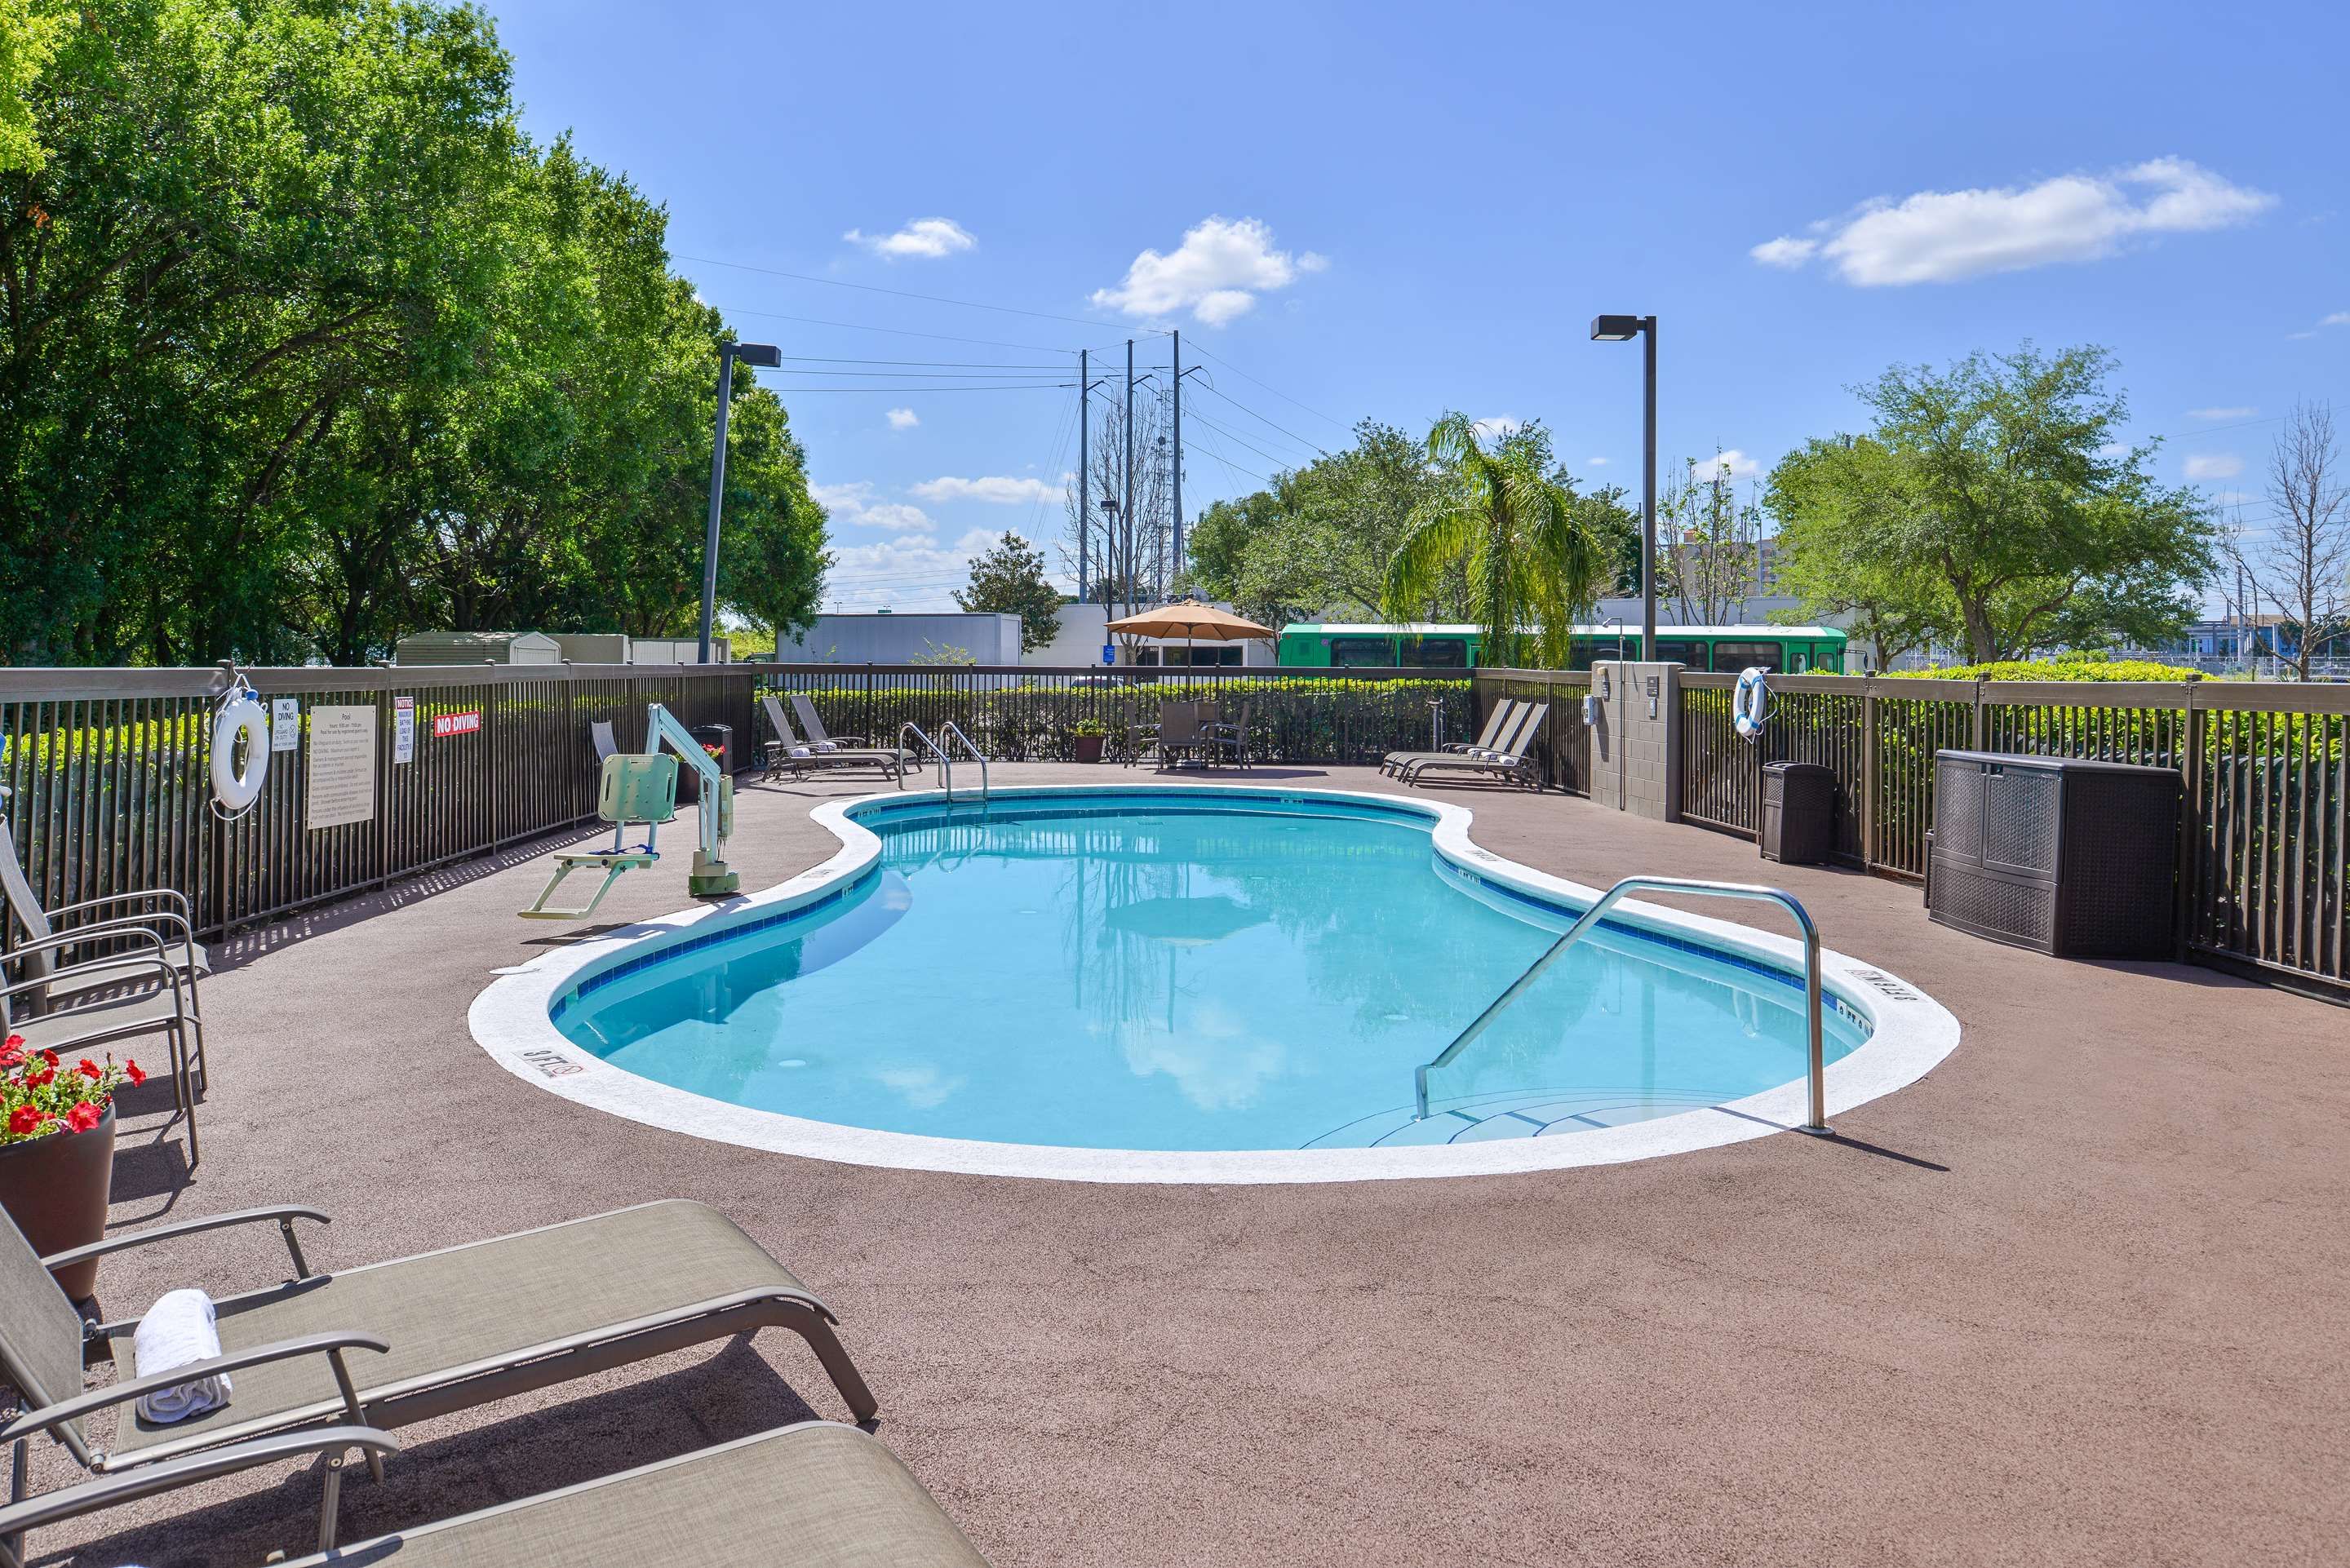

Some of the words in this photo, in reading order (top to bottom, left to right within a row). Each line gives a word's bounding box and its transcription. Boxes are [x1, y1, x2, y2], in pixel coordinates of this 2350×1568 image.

[282, 702, 290, 711] NO
[397, 699, 413, 708] NOTICE
[278, 712, 294, 721] DIVING
[437, 717, 451, 734] NO
[454, 713, 479, 732] DIVING
[1847, 1010, 1856, 1023] FT
[531, 1056, 569, 1067] FT
